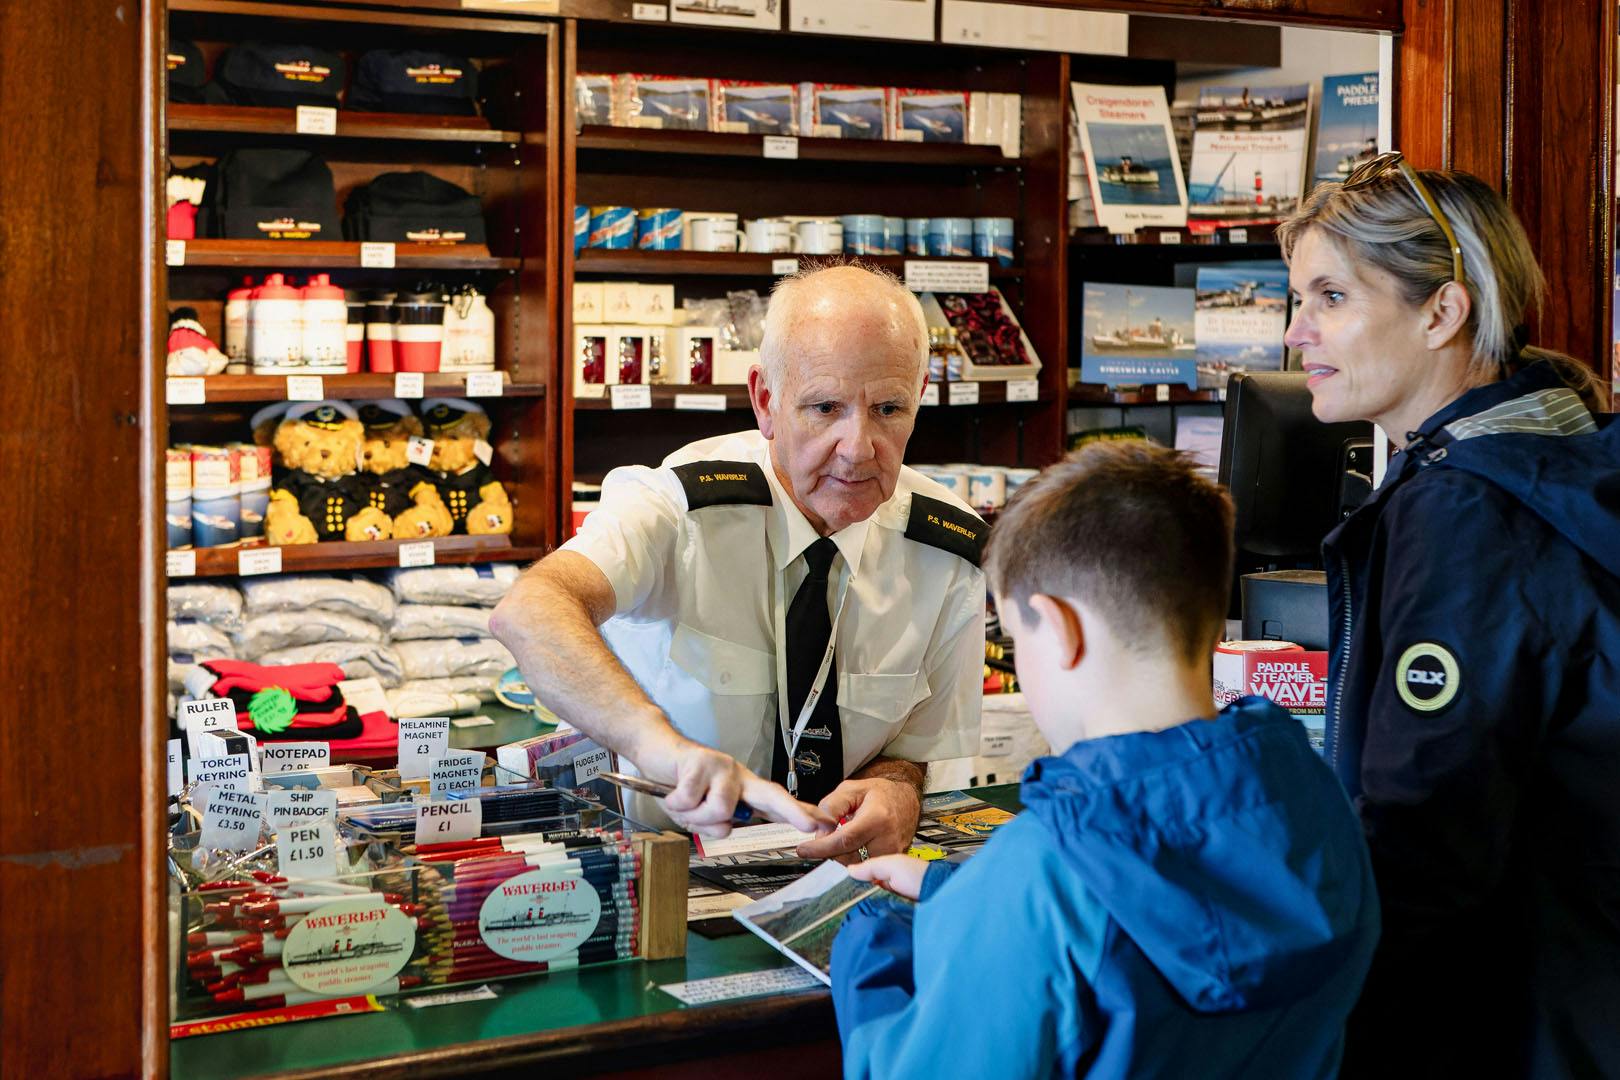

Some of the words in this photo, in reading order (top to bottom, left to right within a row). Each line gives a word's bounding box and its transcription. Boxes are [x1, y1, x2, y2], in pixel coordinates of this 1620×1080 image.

[1336, 84, 1377, 97] PADDLE
[1099, 110, 1147, 121] Steamers
[714, 473, 748, 482] WAVERLEY
[942, 520, 977, 540] WAVERLEY
[1257, 662, 1311, 674] PADDLE
[1252, 672, 1315, 684] STEAMER
[1407, 669, 1447, 685] DLX
[1249, 682, 1328, 703] WAVE
[187, 702, 230, 715] RULER
[204, 717, 218, 727] £2
[400, 720, 449, 730] MELAMINE
[404, 730, 445, 741] MAGNET
[265, 748, 328, 760] NOTEPAD
[416, 744, 430, 755] £3
[200, 757, 242, 769] TORCH
[438, 756, 473, 769] FRIDGE
[575, 754, 594, 769] FUDGE
[594, 751, 609, 764] BOX
[196, 769, 248, 782] KEYRING
[433, 767, 480, 780] MAGNETS
[437, 782, 448, 792] £3
[449, 779, 477, 791] EACH
[218, 791, 257, 806] METAL
[290, 793, 315, 803] SHIP
[208, 803, 261, 819] KEYRING
[273, 807, 292, 816] PIN
[292, 807, 330, 816] BADGE
[421, 803, 473, 818] PENCIL
[217, 819, 246, 831] £3.50
[438, 820, 452, 832] £1
[290, 829, 321, 844] PEN
[547, 830, 579, 842] WAVERLEY
[289, 846, 325, 862] £1.50
[502, 880, 579, 897] WAVERLEY
[305, 909, 389, 930] WAVERLEY
[497, 935, 510, 945] The
[510, 933, 536, 944] world's
[536, 932, 549, 942] last
[511, 943, 534, 955] paddle
[302, 970, 318, 981] The
[317, 967, 344, 979] world's
[344, 965, 359, 976] last
[317, 976, 342, 990] paddle
